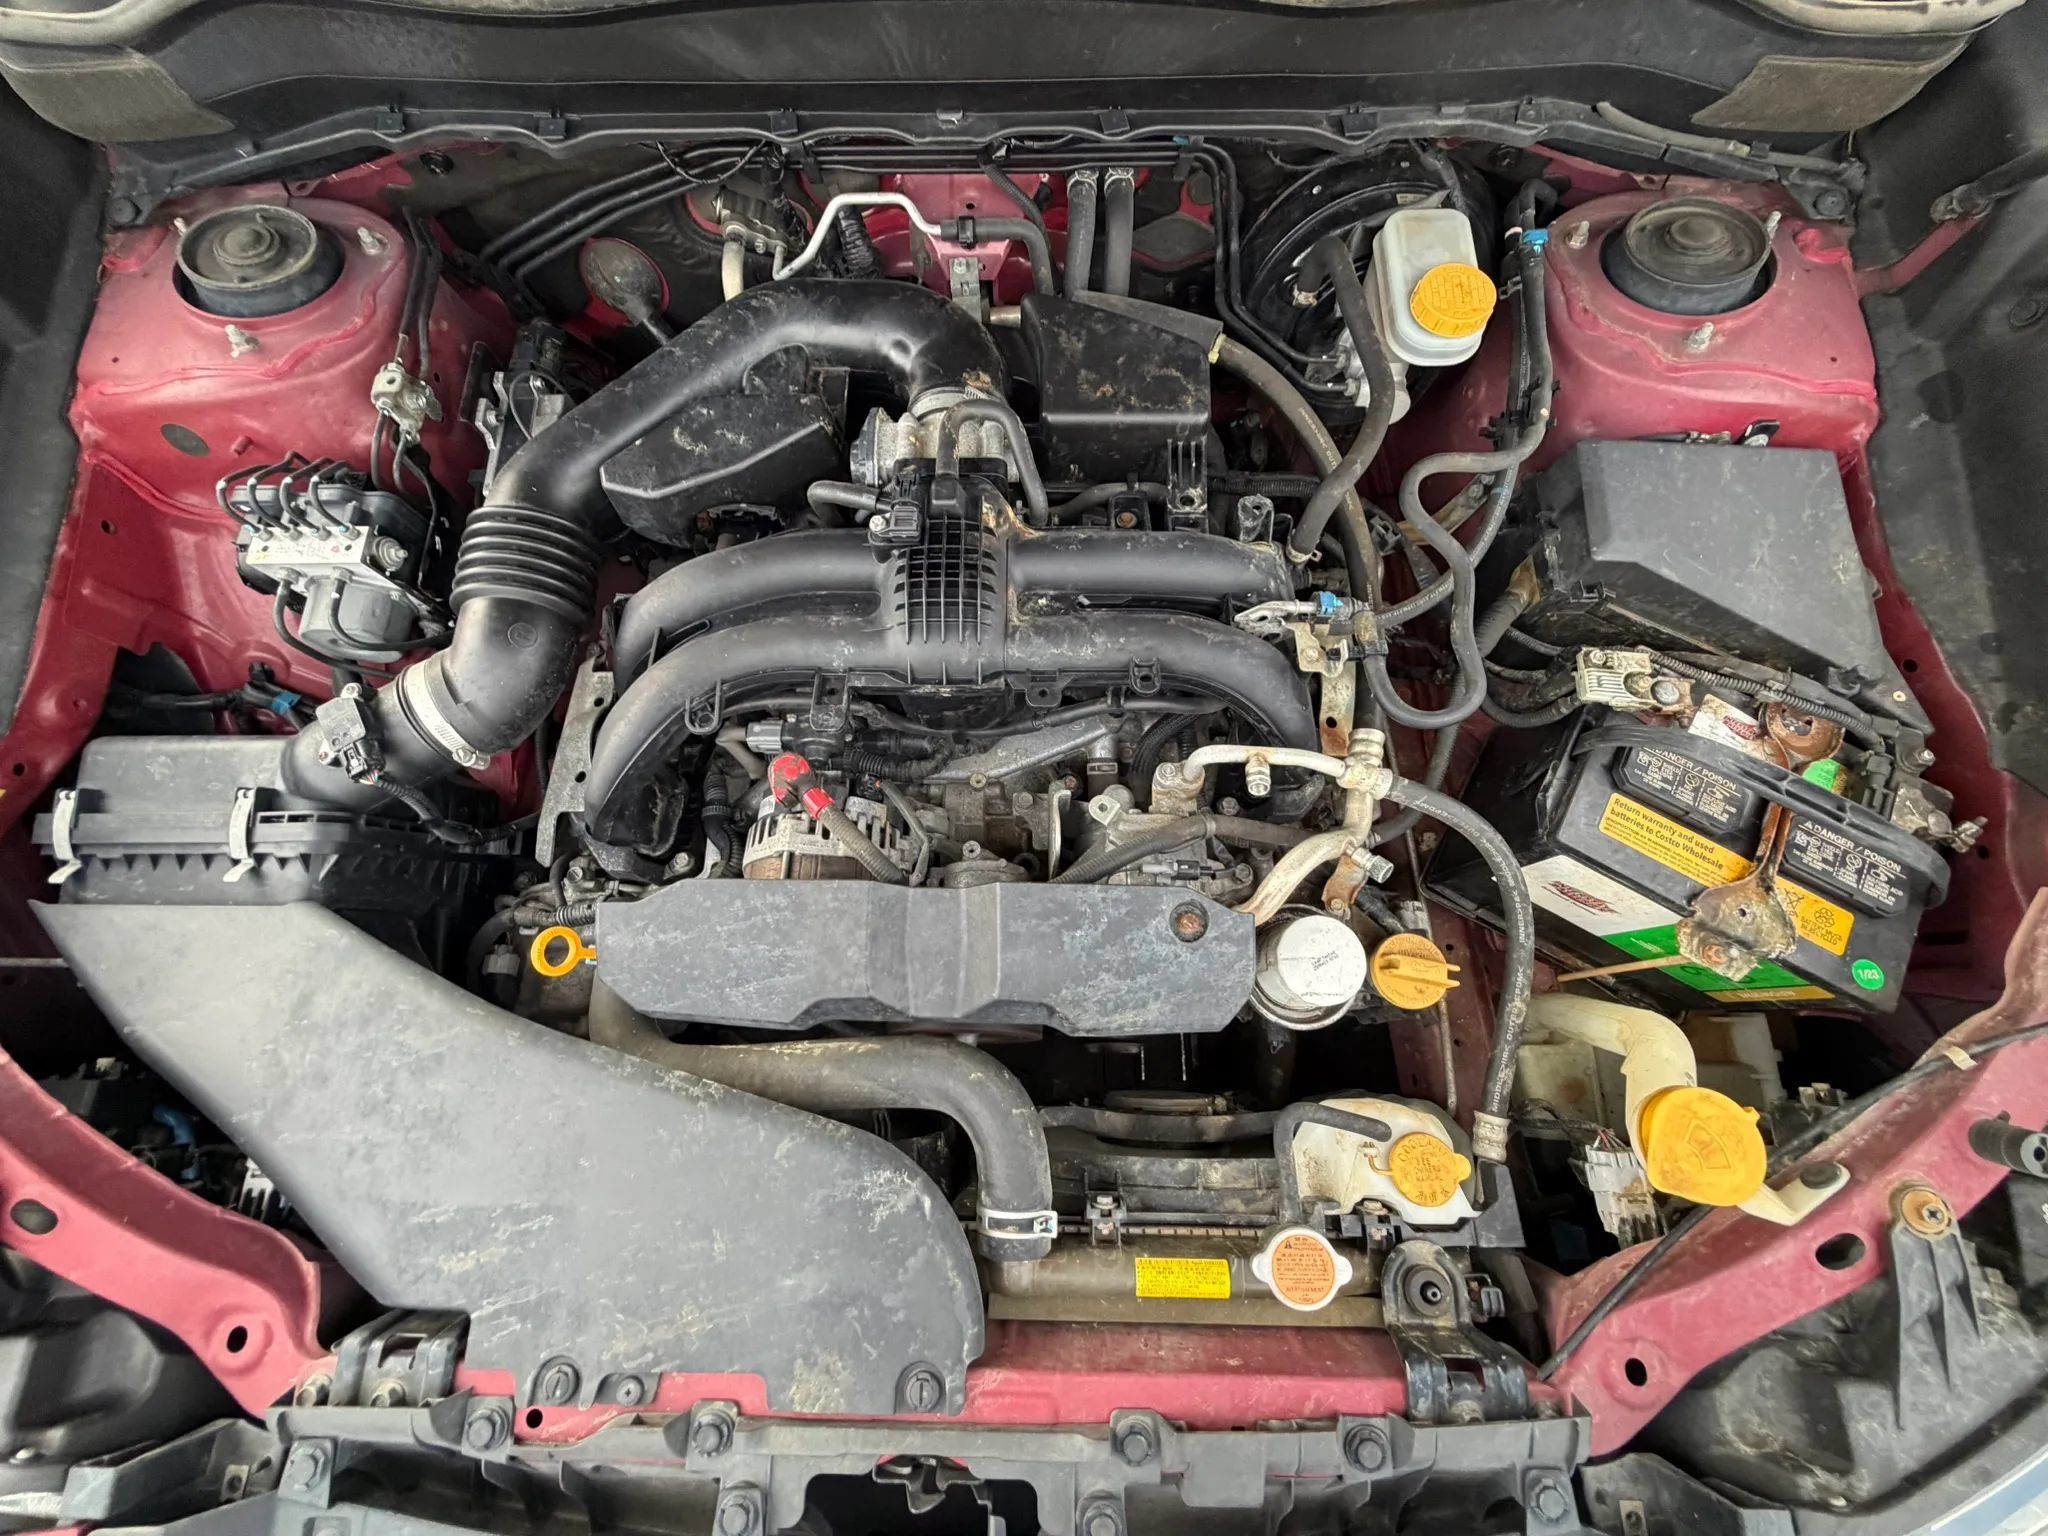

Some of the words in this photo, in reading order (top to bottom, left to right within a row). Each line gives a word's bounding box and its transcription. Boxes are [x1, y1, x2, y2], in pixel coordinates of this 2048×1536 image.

[1701, 768, 1737, 790] POISON
[1610, 807, 1645, 829] batteries
[1645, 825, 1655, 835] to
[1655, 830, 1680, 847] Costco
[1681, 843, 1723, 869] Wholesale
[1614, 798, 1641, 816] Return
[1641, 813, 1676, 835] warranty
[1676, 829, 1694, 843] and
[1694, 838, 1715, 854] used
[1812, 824, 1855, 850] DANGER
[1862, 848, 1902, 873] POISON
